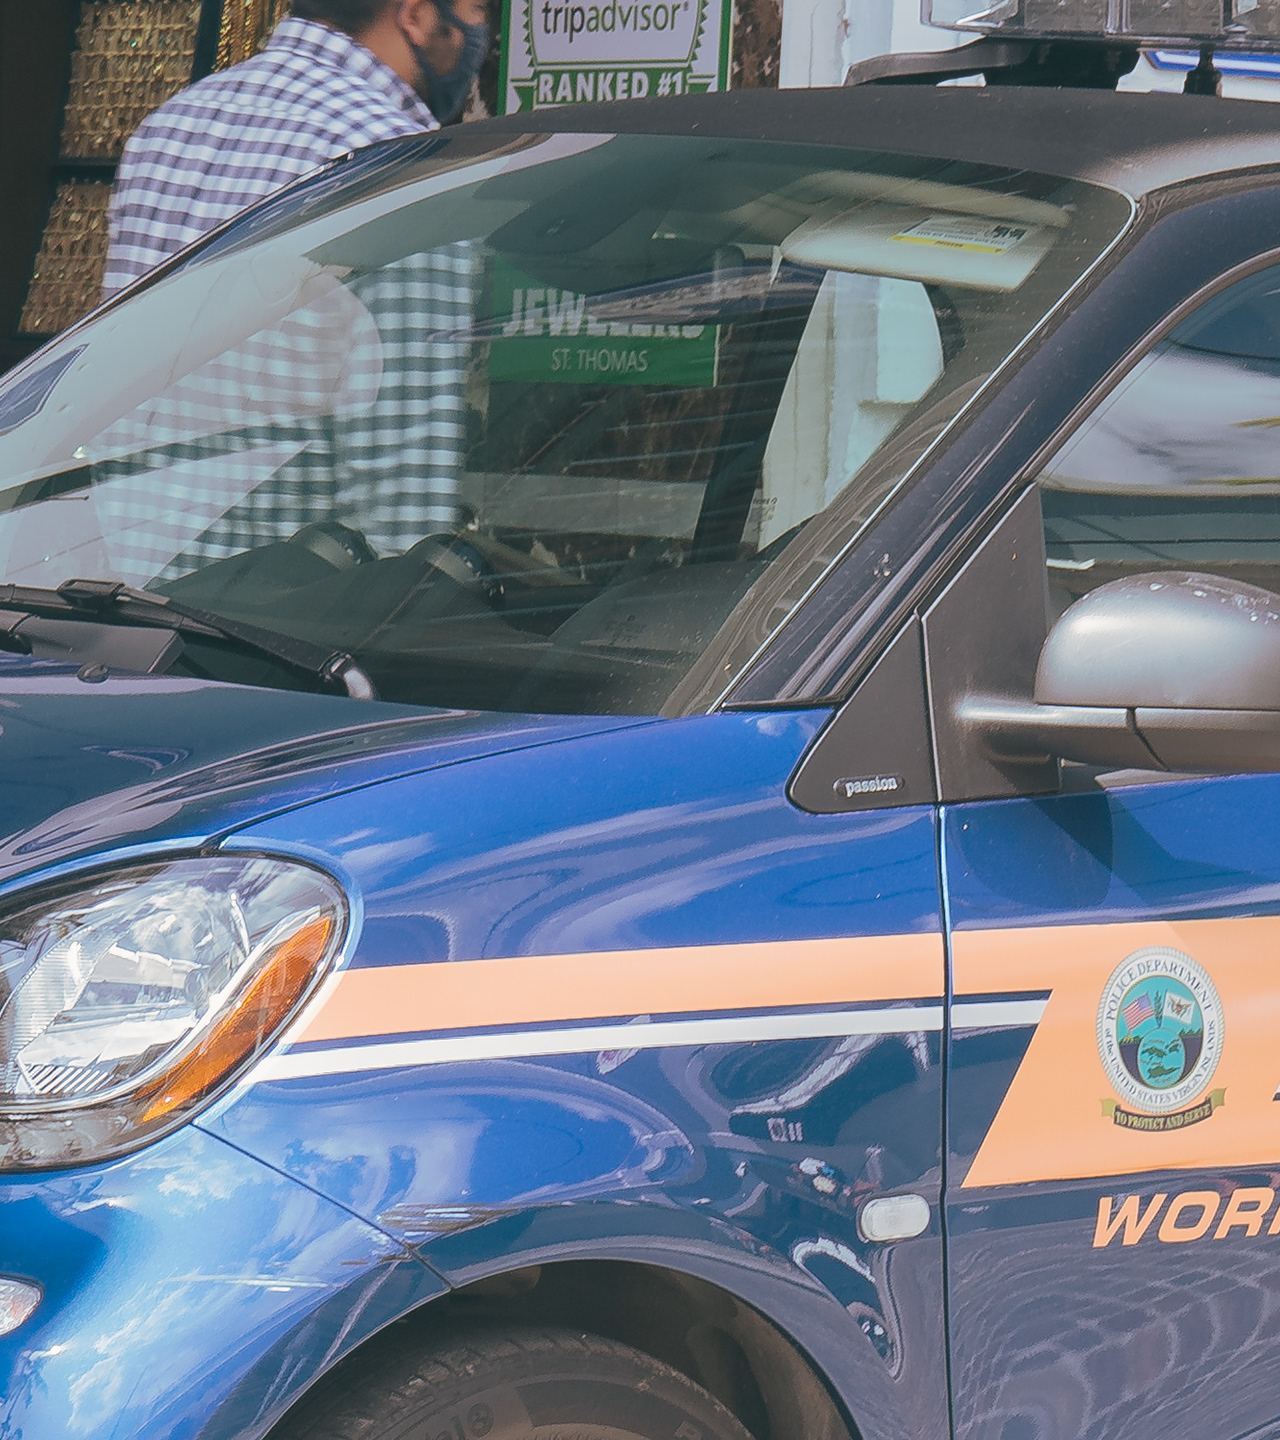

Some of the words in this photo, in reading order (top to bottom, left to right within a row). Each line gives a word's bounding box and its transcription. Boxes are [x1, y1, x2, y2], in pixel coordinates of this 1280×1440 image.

[537, 71, 649, 103] RANKED
[657, 71, 686, 97] #1
[577, 348, 648, 372] THOMAS
[845, 776, 898, 798] passion
[1106, 967, 1137, 1020] POLICE
[1137, 959, 1213, 1011] DEPARTMENT
[1127, 1116, 1164, 1130] PROTECT
[1165, 1116, 1184, 1130] AND
